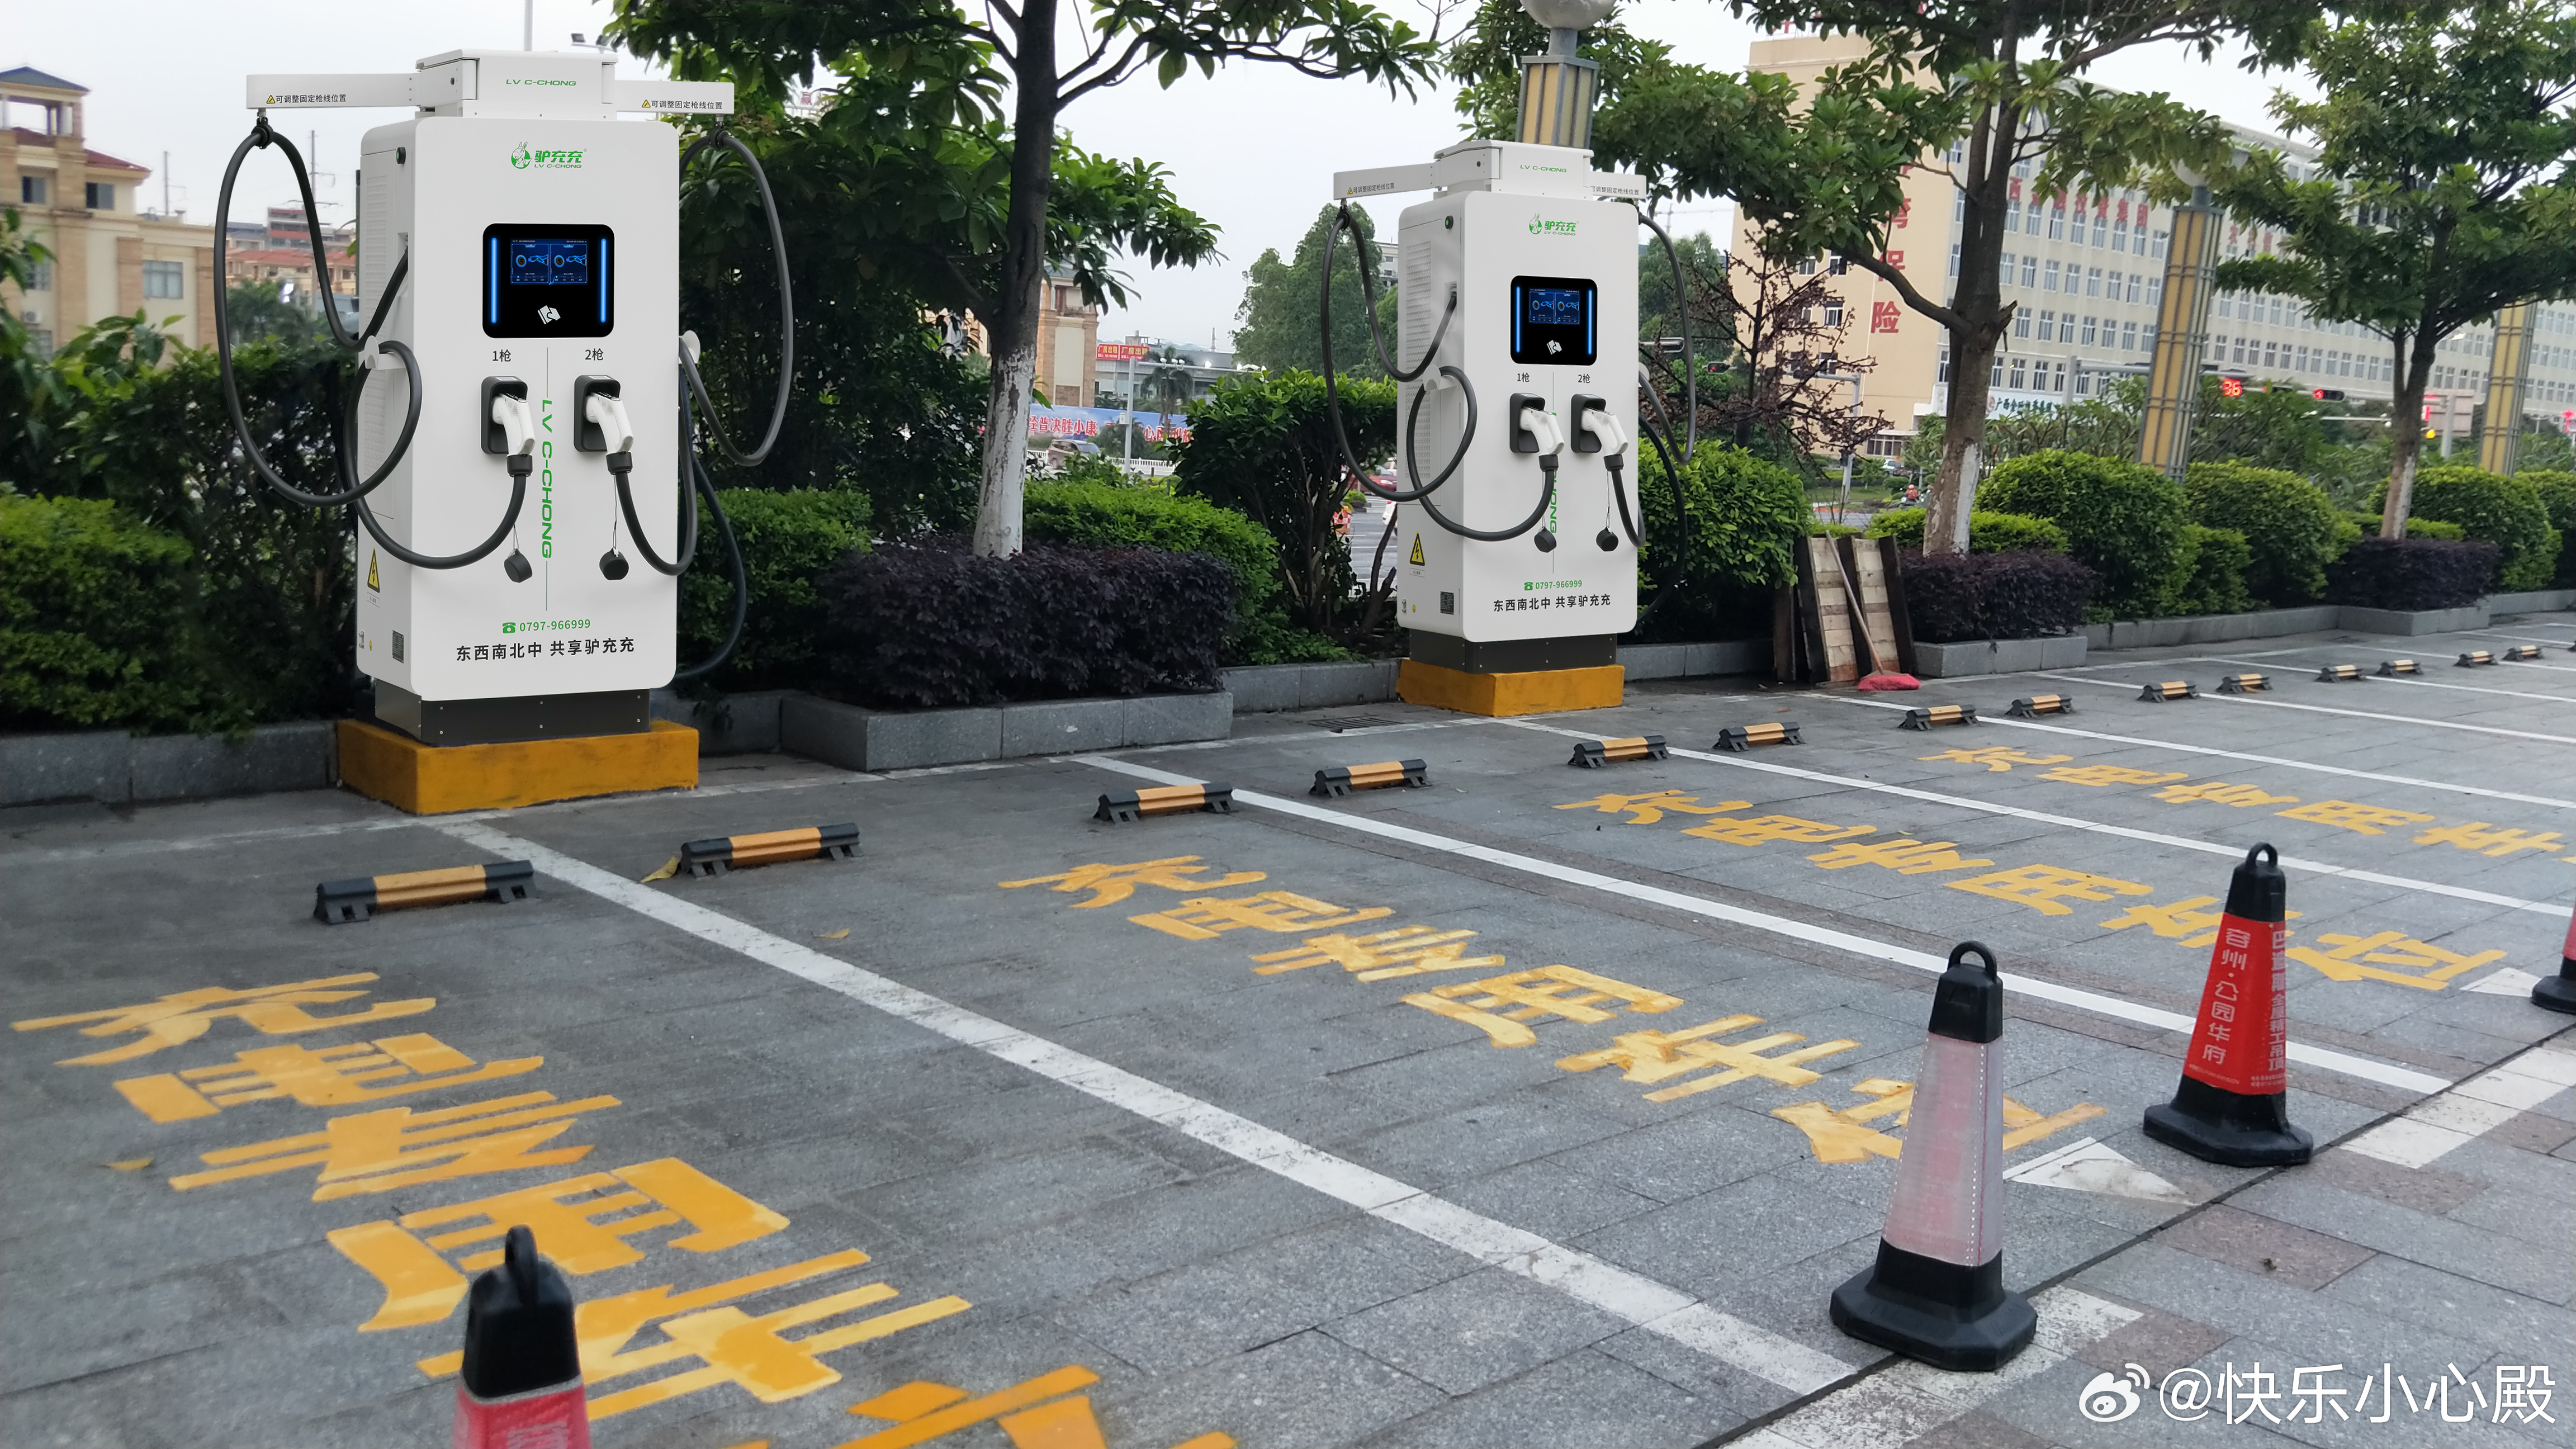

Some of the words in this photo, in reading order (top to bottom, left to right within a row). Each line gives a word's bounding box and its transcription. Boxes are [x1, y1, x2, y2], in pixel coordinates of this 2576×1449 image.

[276, 94, 347, 105] 可调整固定枪线位置
[651, 100, 723, 110] 可调整固定枪线位置
[534, 149, 583, 163] 驴充充
[1353, 182, 1395, 193] 可调整固定枪线位置
[1544, 220, 1576, 233] 驴充充
[493, 349, 512, 362] 1枪
[585, 348, 604, 361] 2枪
[1517, 372, 1530, 383] 1枪
[1578, 373, 1590, 384] 2枪
[542, 400, 552, 433] LV
[542, 441, 552, 558] C-CHONG
[1535, 579, 1583, 590] 0797-966999
[1493, 596, 1551, 612] 东西南北中
[1555, 593, 1611, 607] 共享驴充充
[519, 619, 591, 632] 0797-966999
[456, 641, 543, 661] 东西南北中
[550, 637, 635, 656] 共享驴充充
[1918, 746, 2576, 859] 充电专用车
